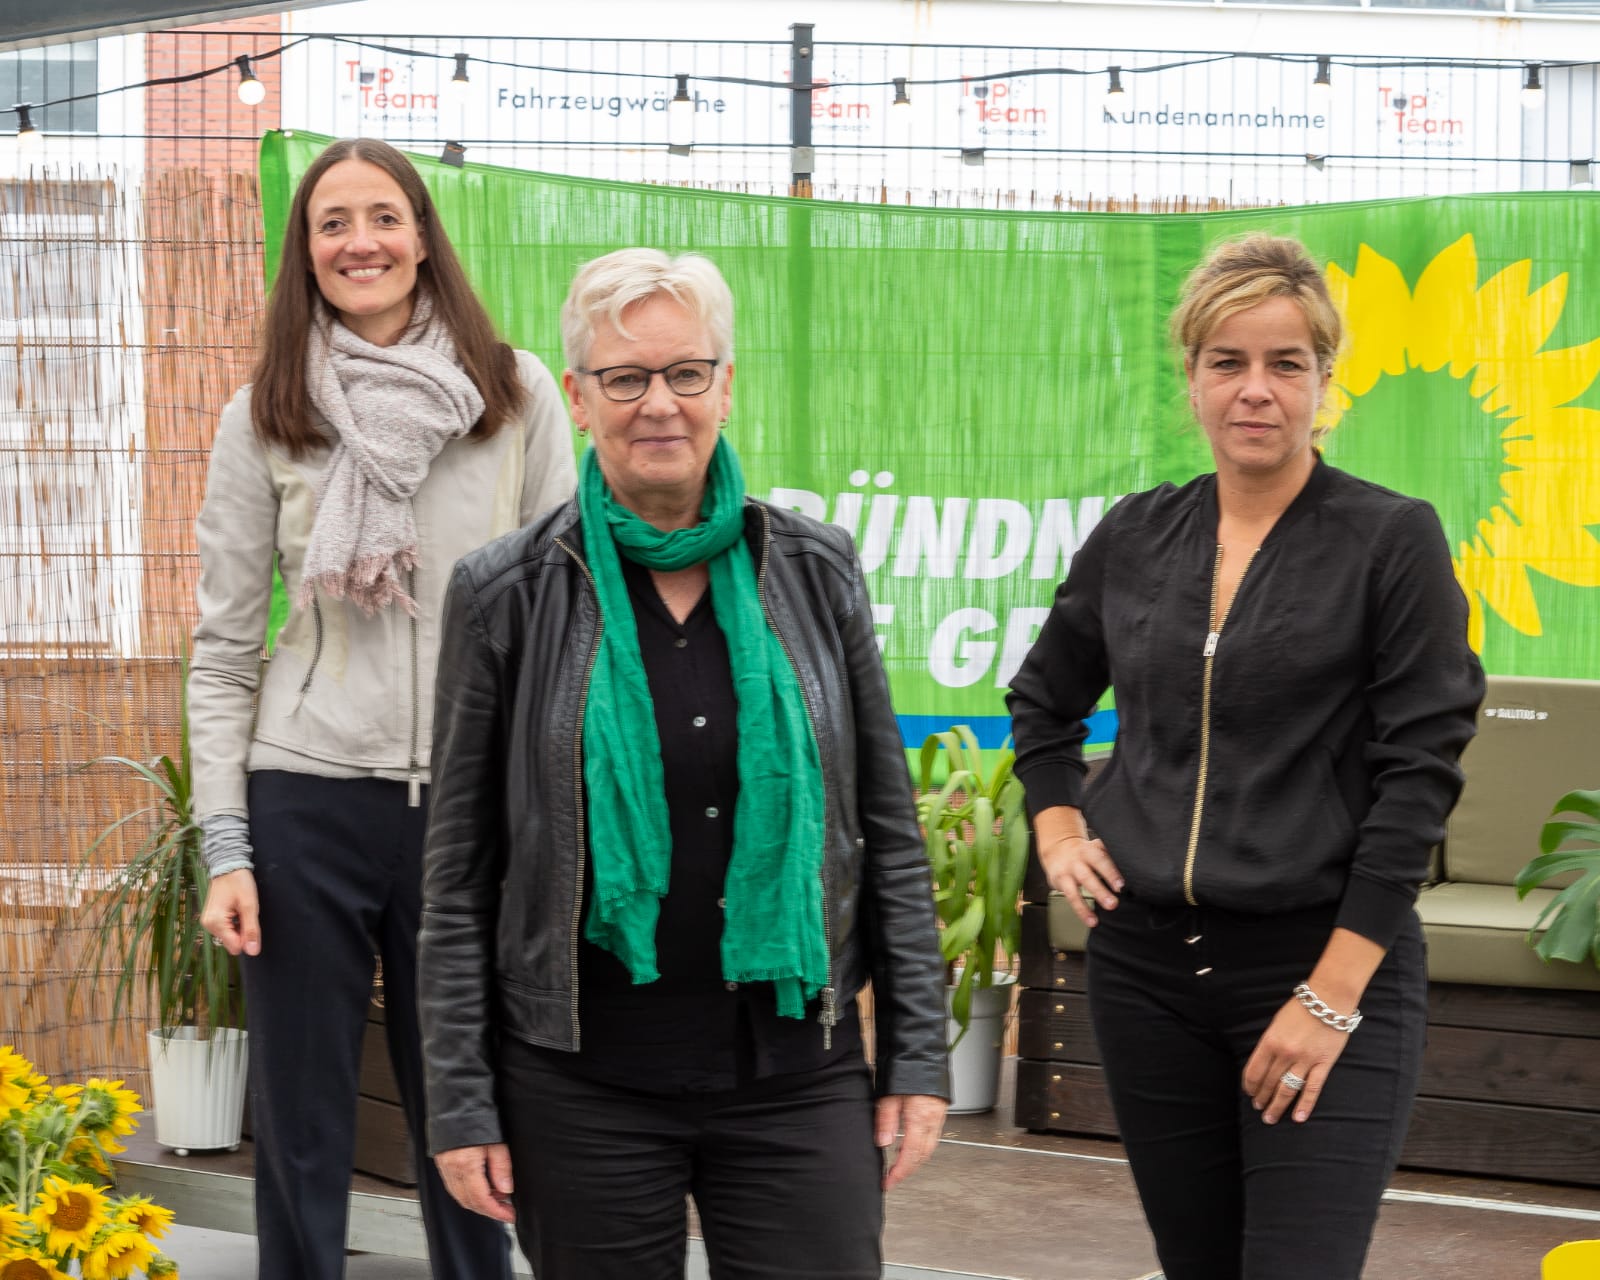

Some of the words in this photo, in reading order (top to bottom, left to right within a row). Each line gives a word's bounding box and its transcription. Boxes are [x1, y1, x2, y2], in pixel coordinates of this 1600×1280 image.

[360, 86, 438, 109] Team
[498, 87, 727, 117] Fahrzeugwähe
[812, 101, 870, 119] eam
[975, 100, 1047, 123] Team
[1103, 103, 1326, 129] Kundenannahme
[1394, 112, 1464, 135] Team
